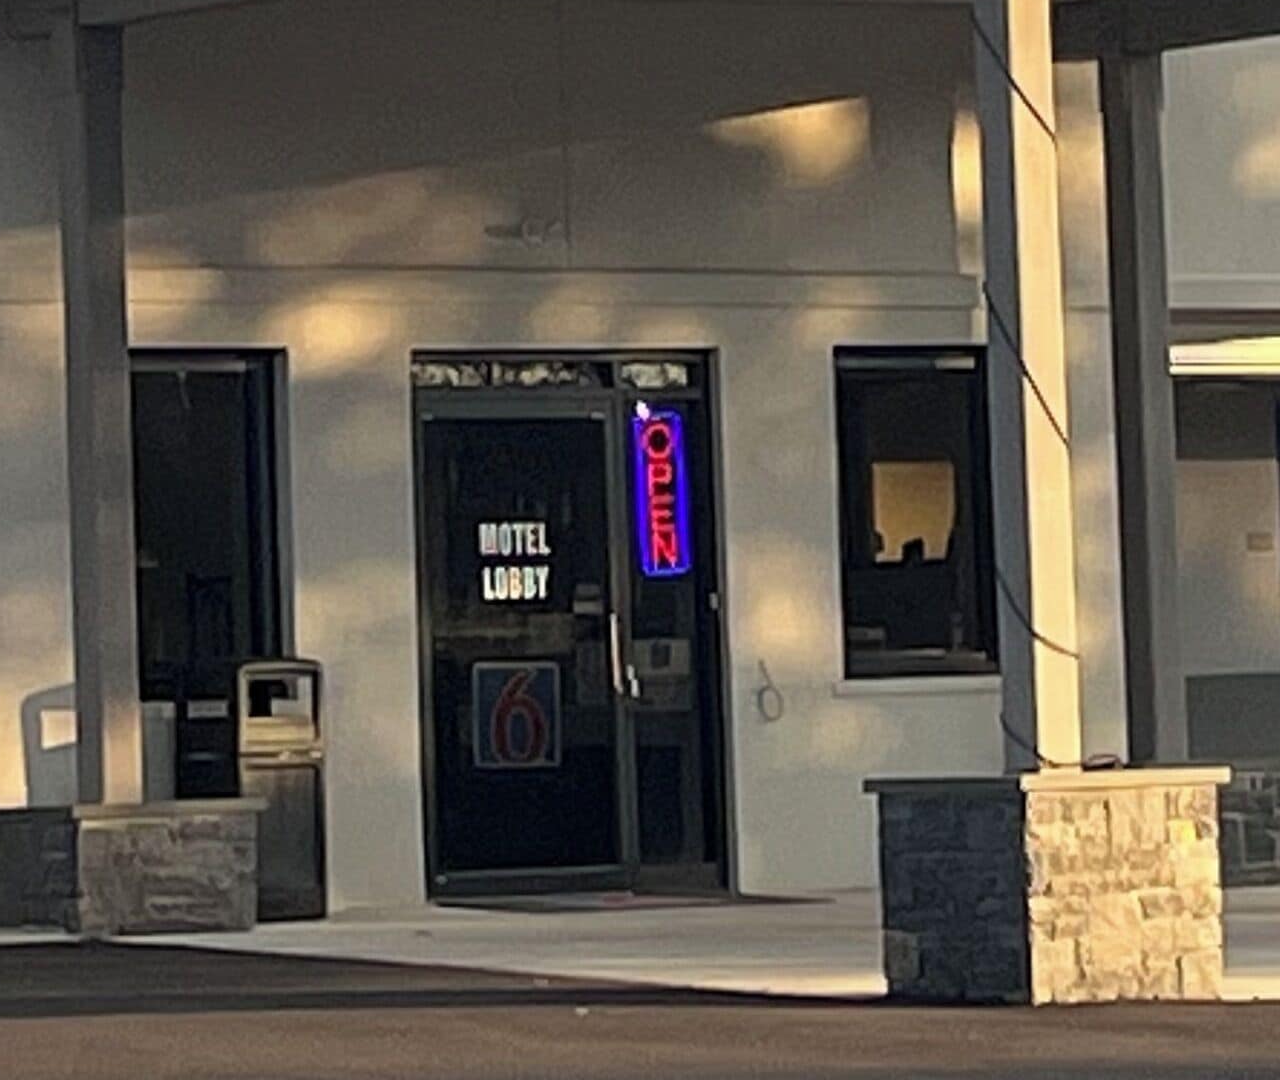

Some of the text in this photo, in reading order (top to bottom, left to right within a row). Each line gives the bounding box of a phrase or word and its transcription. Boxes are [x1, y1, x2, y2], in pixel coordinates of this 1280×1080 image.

[644, 422, 678, 570] OPEN
[479, 521, 551, 557] MOTEL
[482, 565, 549, 600] LOBBY
[490, 668, 549, 764] 6
